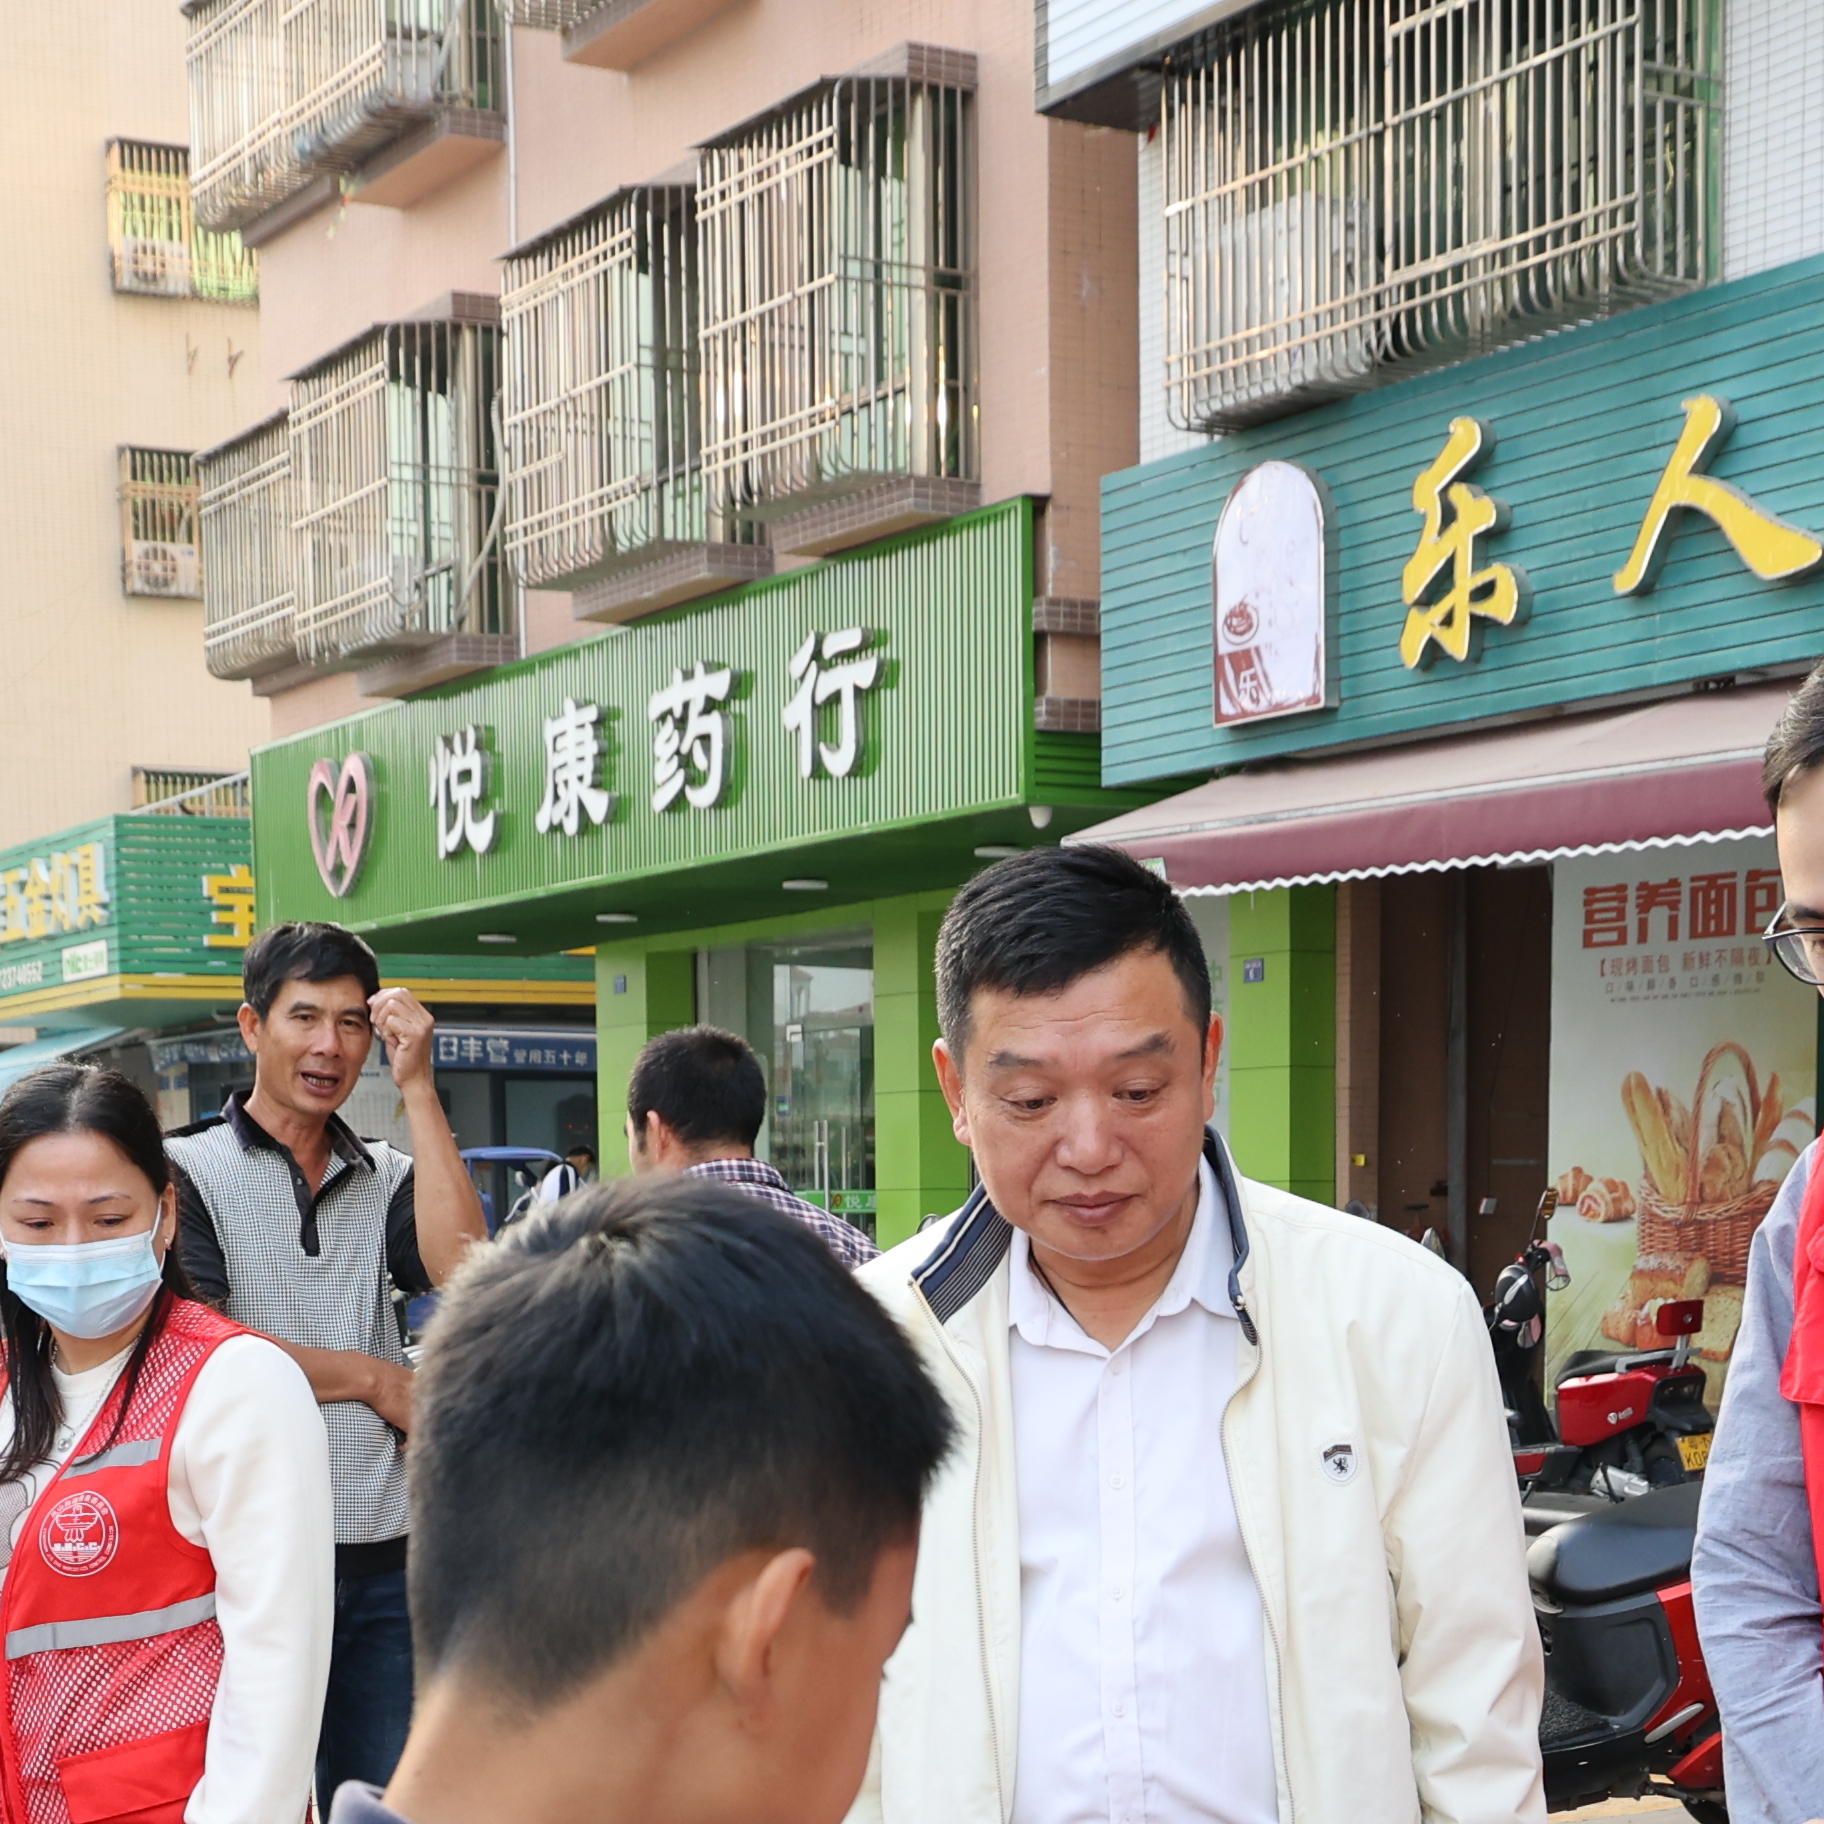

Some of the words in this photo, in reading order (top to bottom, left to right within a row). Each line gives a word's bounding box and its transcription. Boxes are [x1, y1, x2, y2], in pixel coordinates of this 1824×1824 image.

[428, 625, 888, 861] 悦康药行
[1583, 868, 1786, 949] 营养面包
